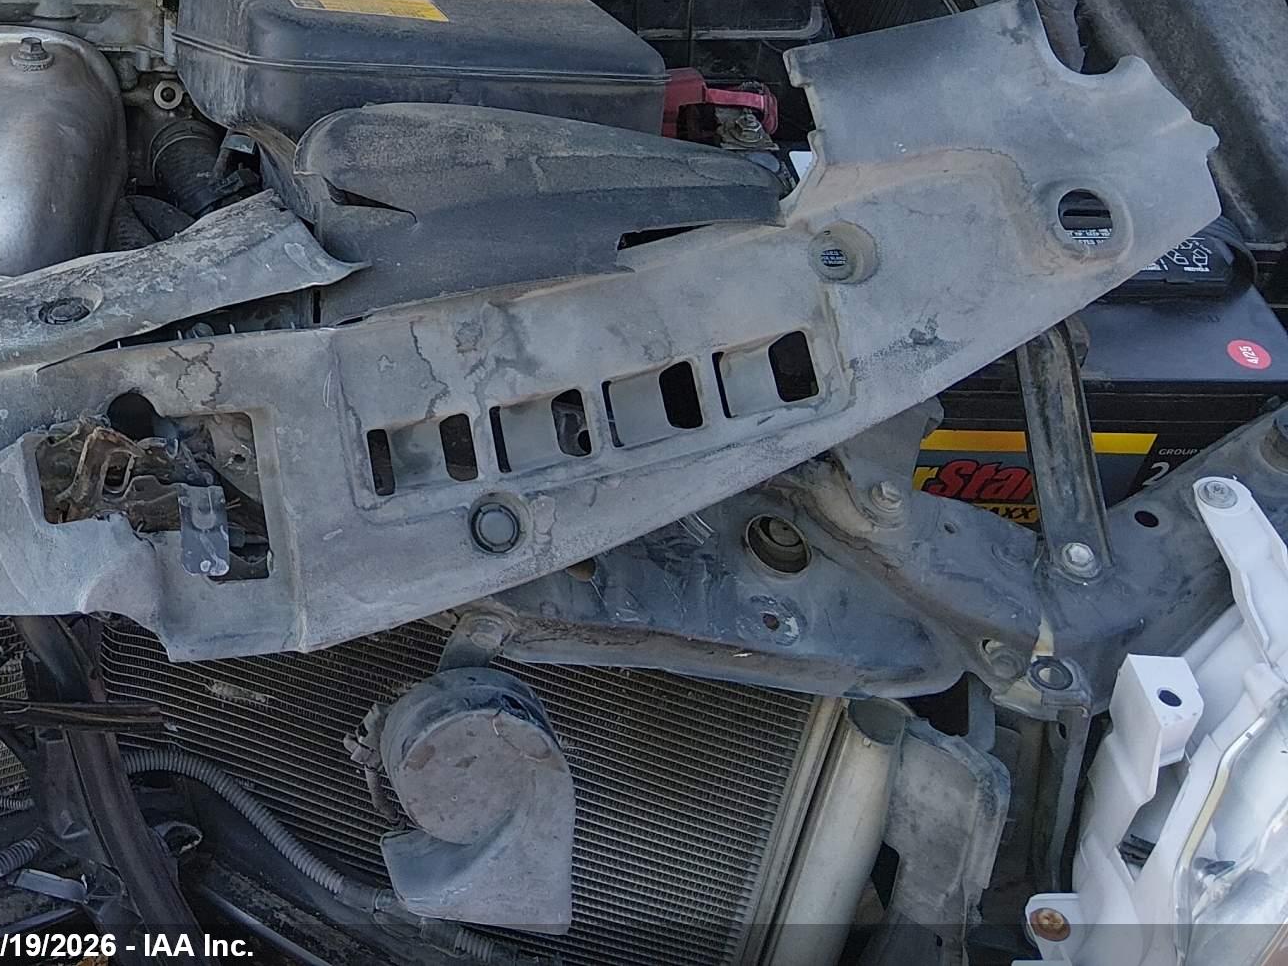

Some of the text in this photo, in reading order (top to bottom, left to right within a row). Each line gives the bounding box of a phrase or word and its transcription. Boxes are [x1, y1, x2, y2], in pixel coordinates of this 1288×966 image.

[1158, 447, 1199, 456] GROUP
[1140, 461, 1170, 487] 2
[982, 506, 1036, 519] AXX
